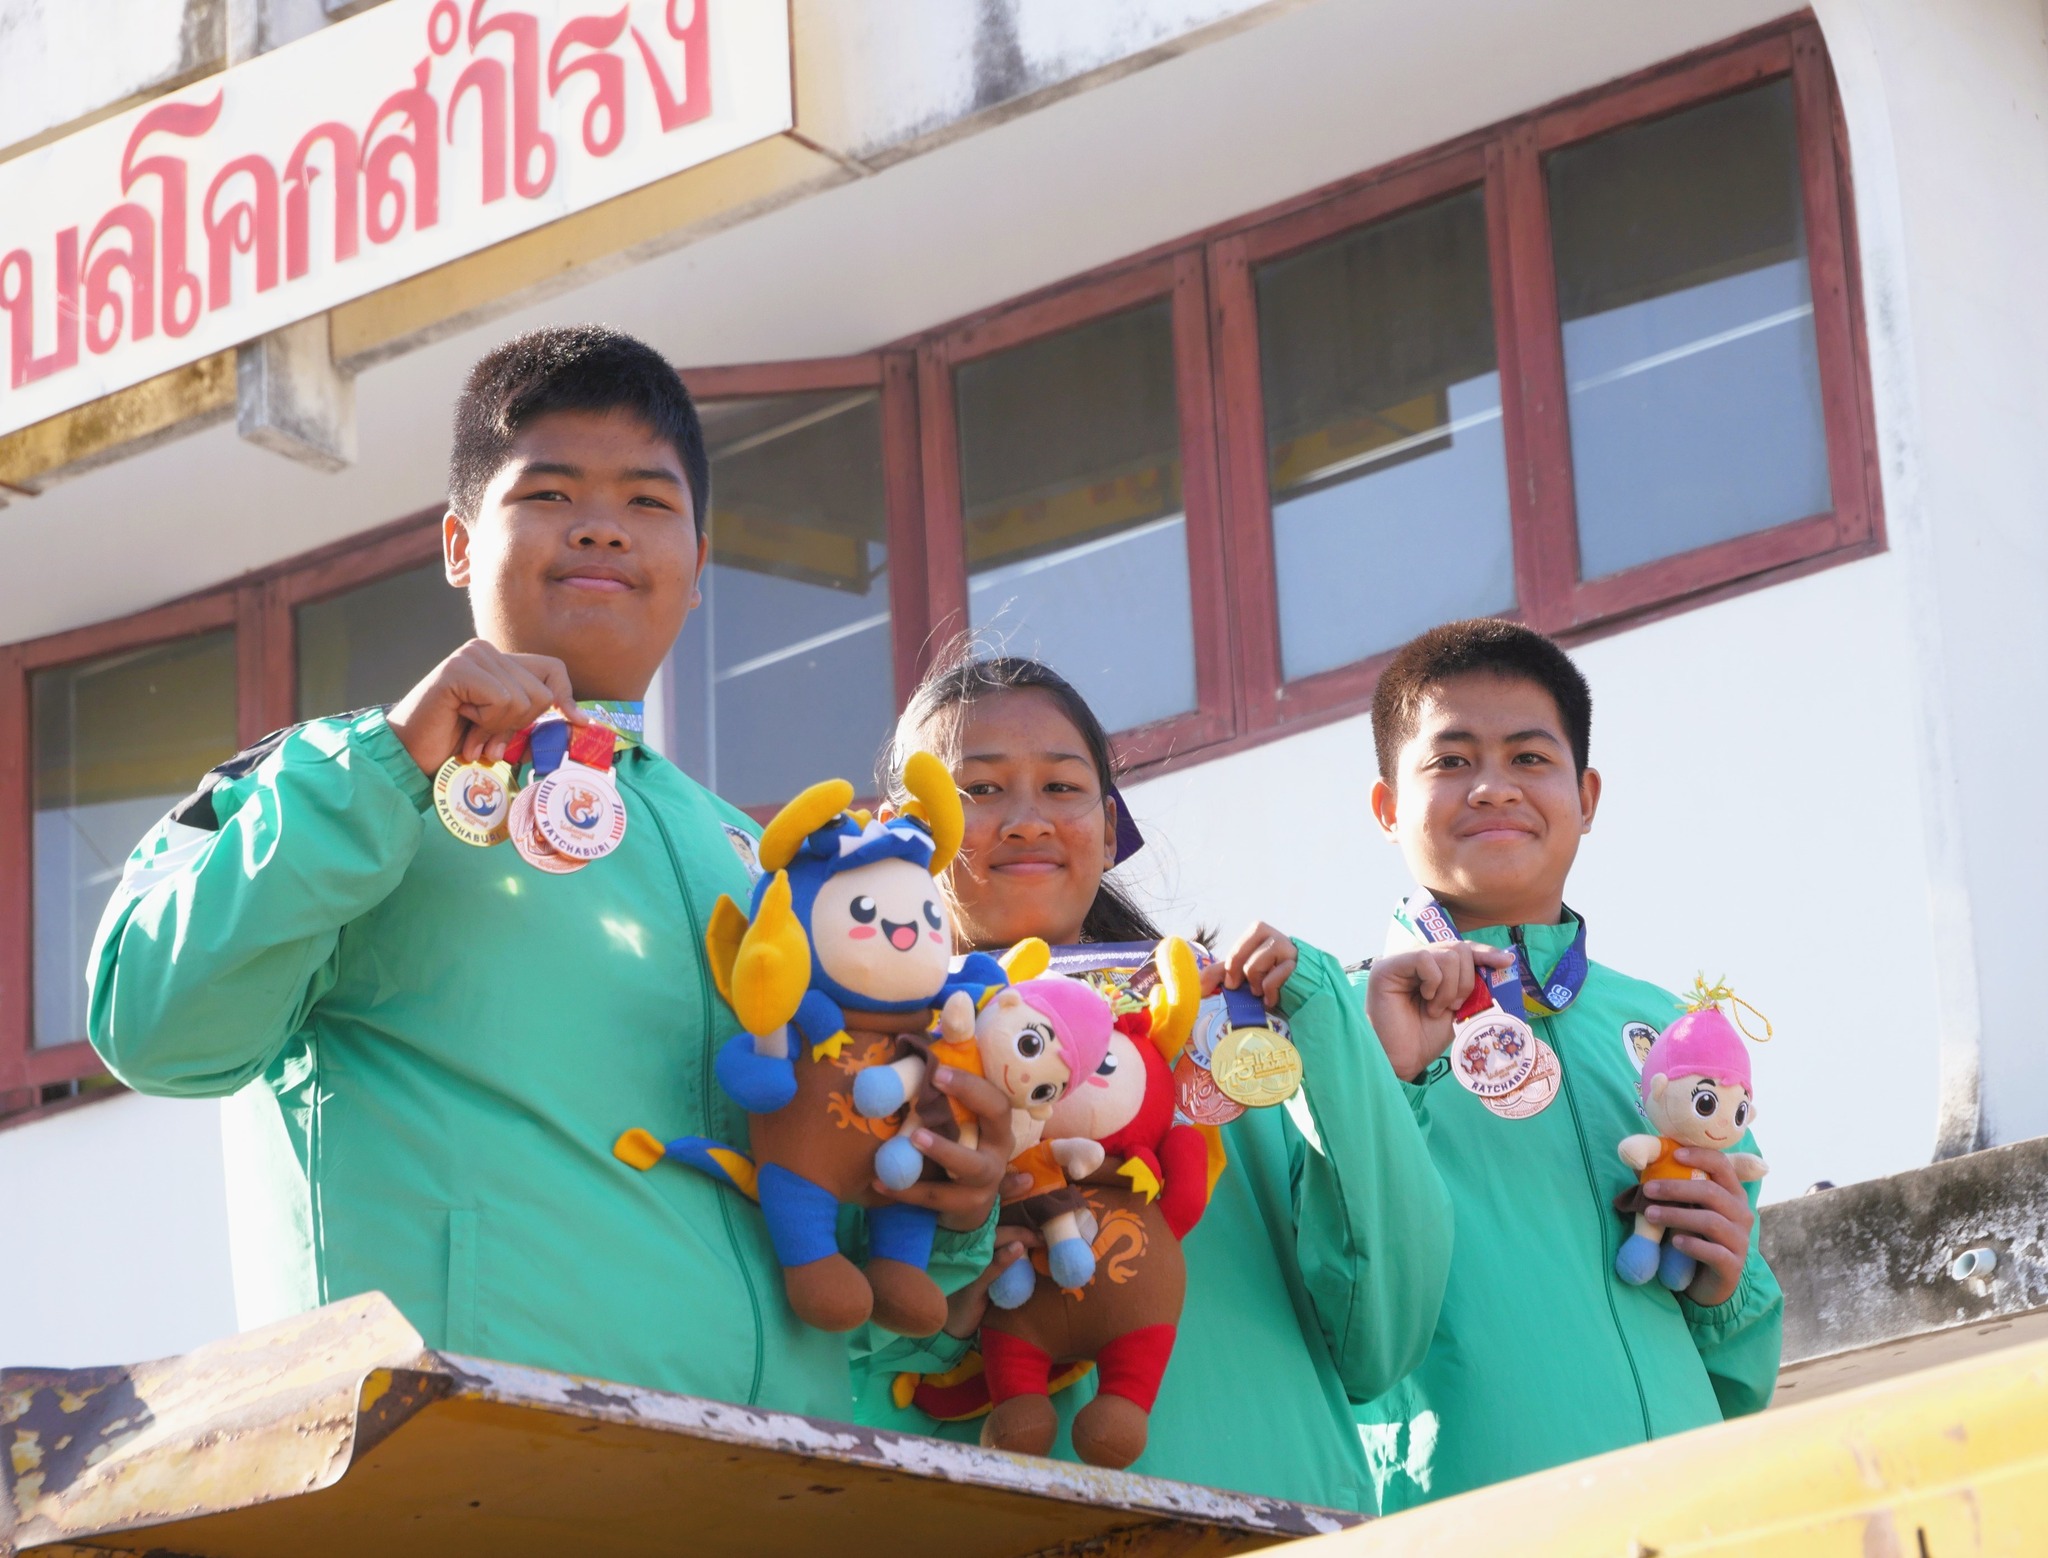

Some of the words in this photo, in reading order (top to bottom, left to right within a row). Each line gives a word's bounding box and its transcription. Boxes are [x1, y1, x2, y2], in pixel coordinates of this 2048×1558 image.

[438, 798, 502, 845] RATCHABURI
[541, 820, 611, 860] RATCHABURI
[1471, 1057, 1533, 1093] RATCHABURI
